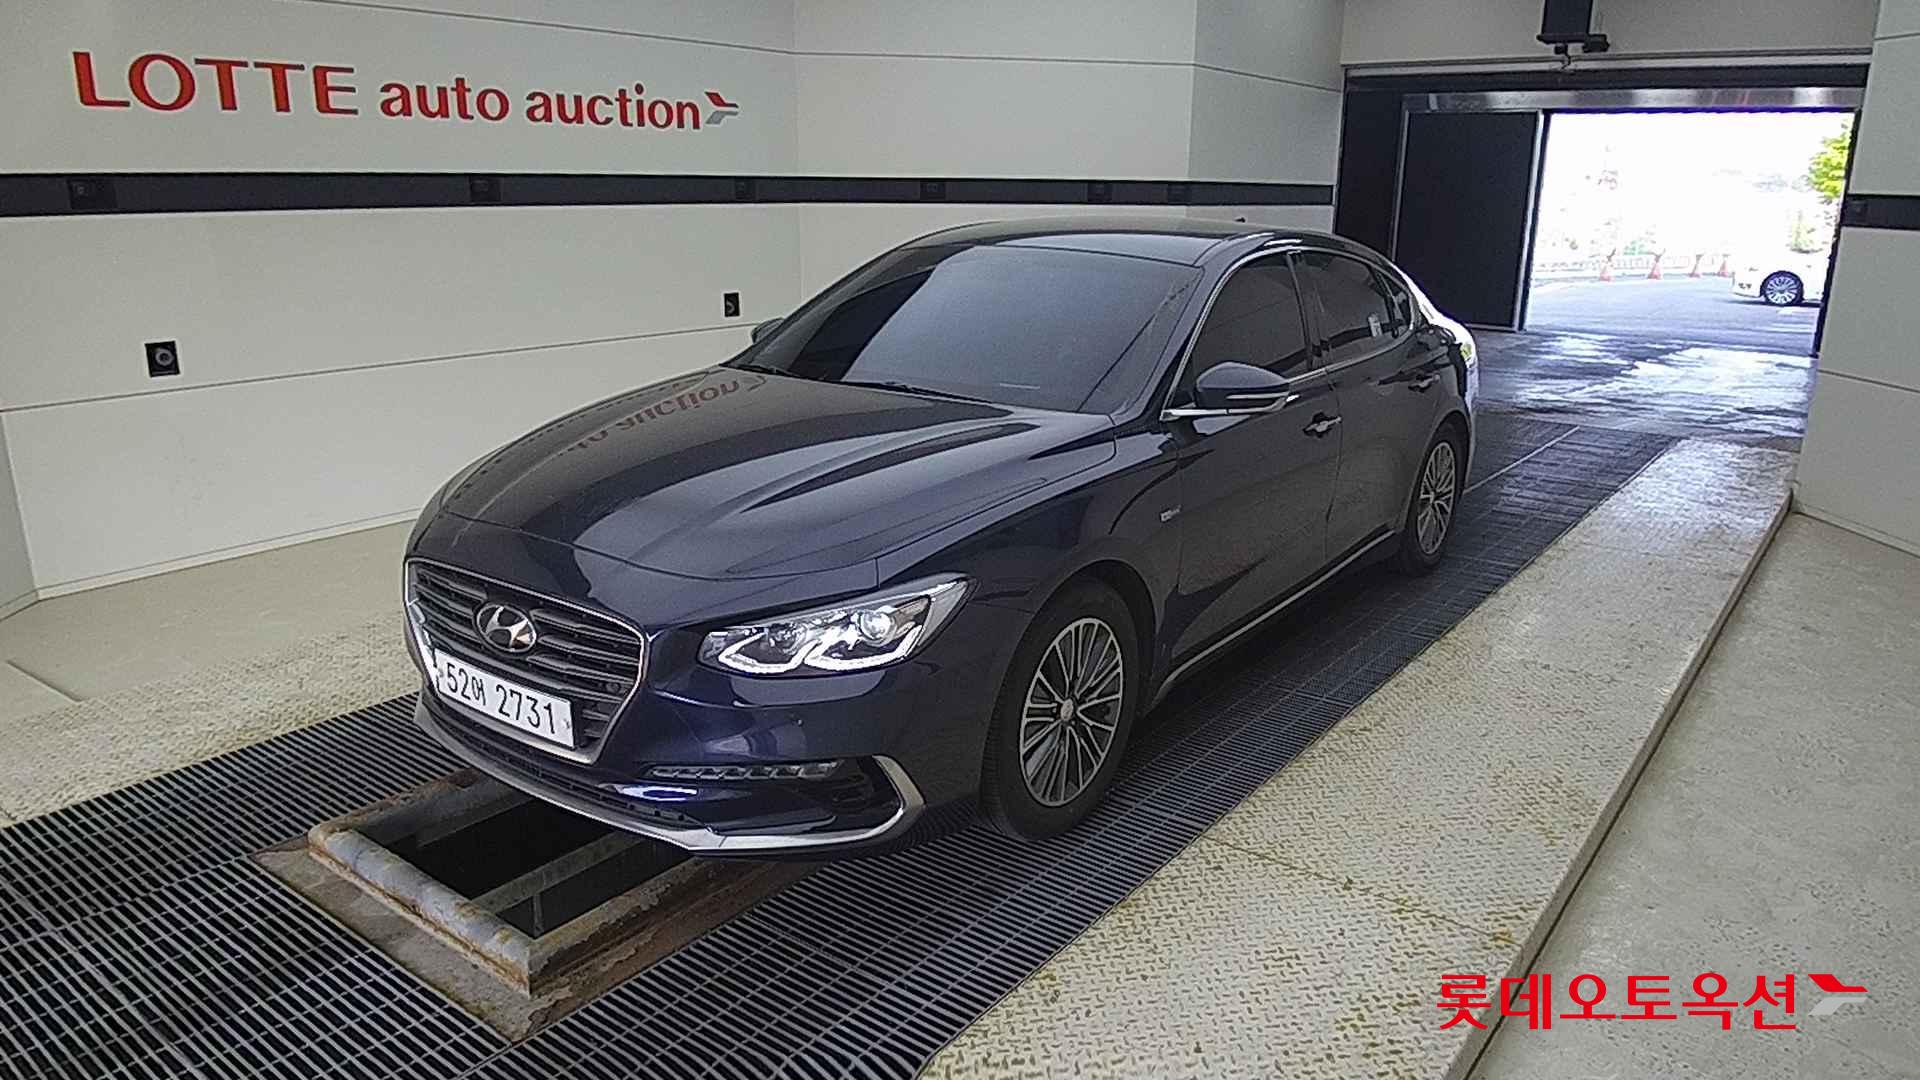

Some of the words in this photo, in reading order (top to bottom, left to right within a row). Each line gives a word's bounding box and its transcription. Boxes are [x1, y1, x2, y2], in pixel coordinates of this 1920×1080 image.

[73, 51, 359, 117] LOTTE
[380, 77, 510, 121] auto
[526, 83, 701, 130] auction
[446, 662, 487, 706] 52어
[495, 684, 555, 735] 2731
